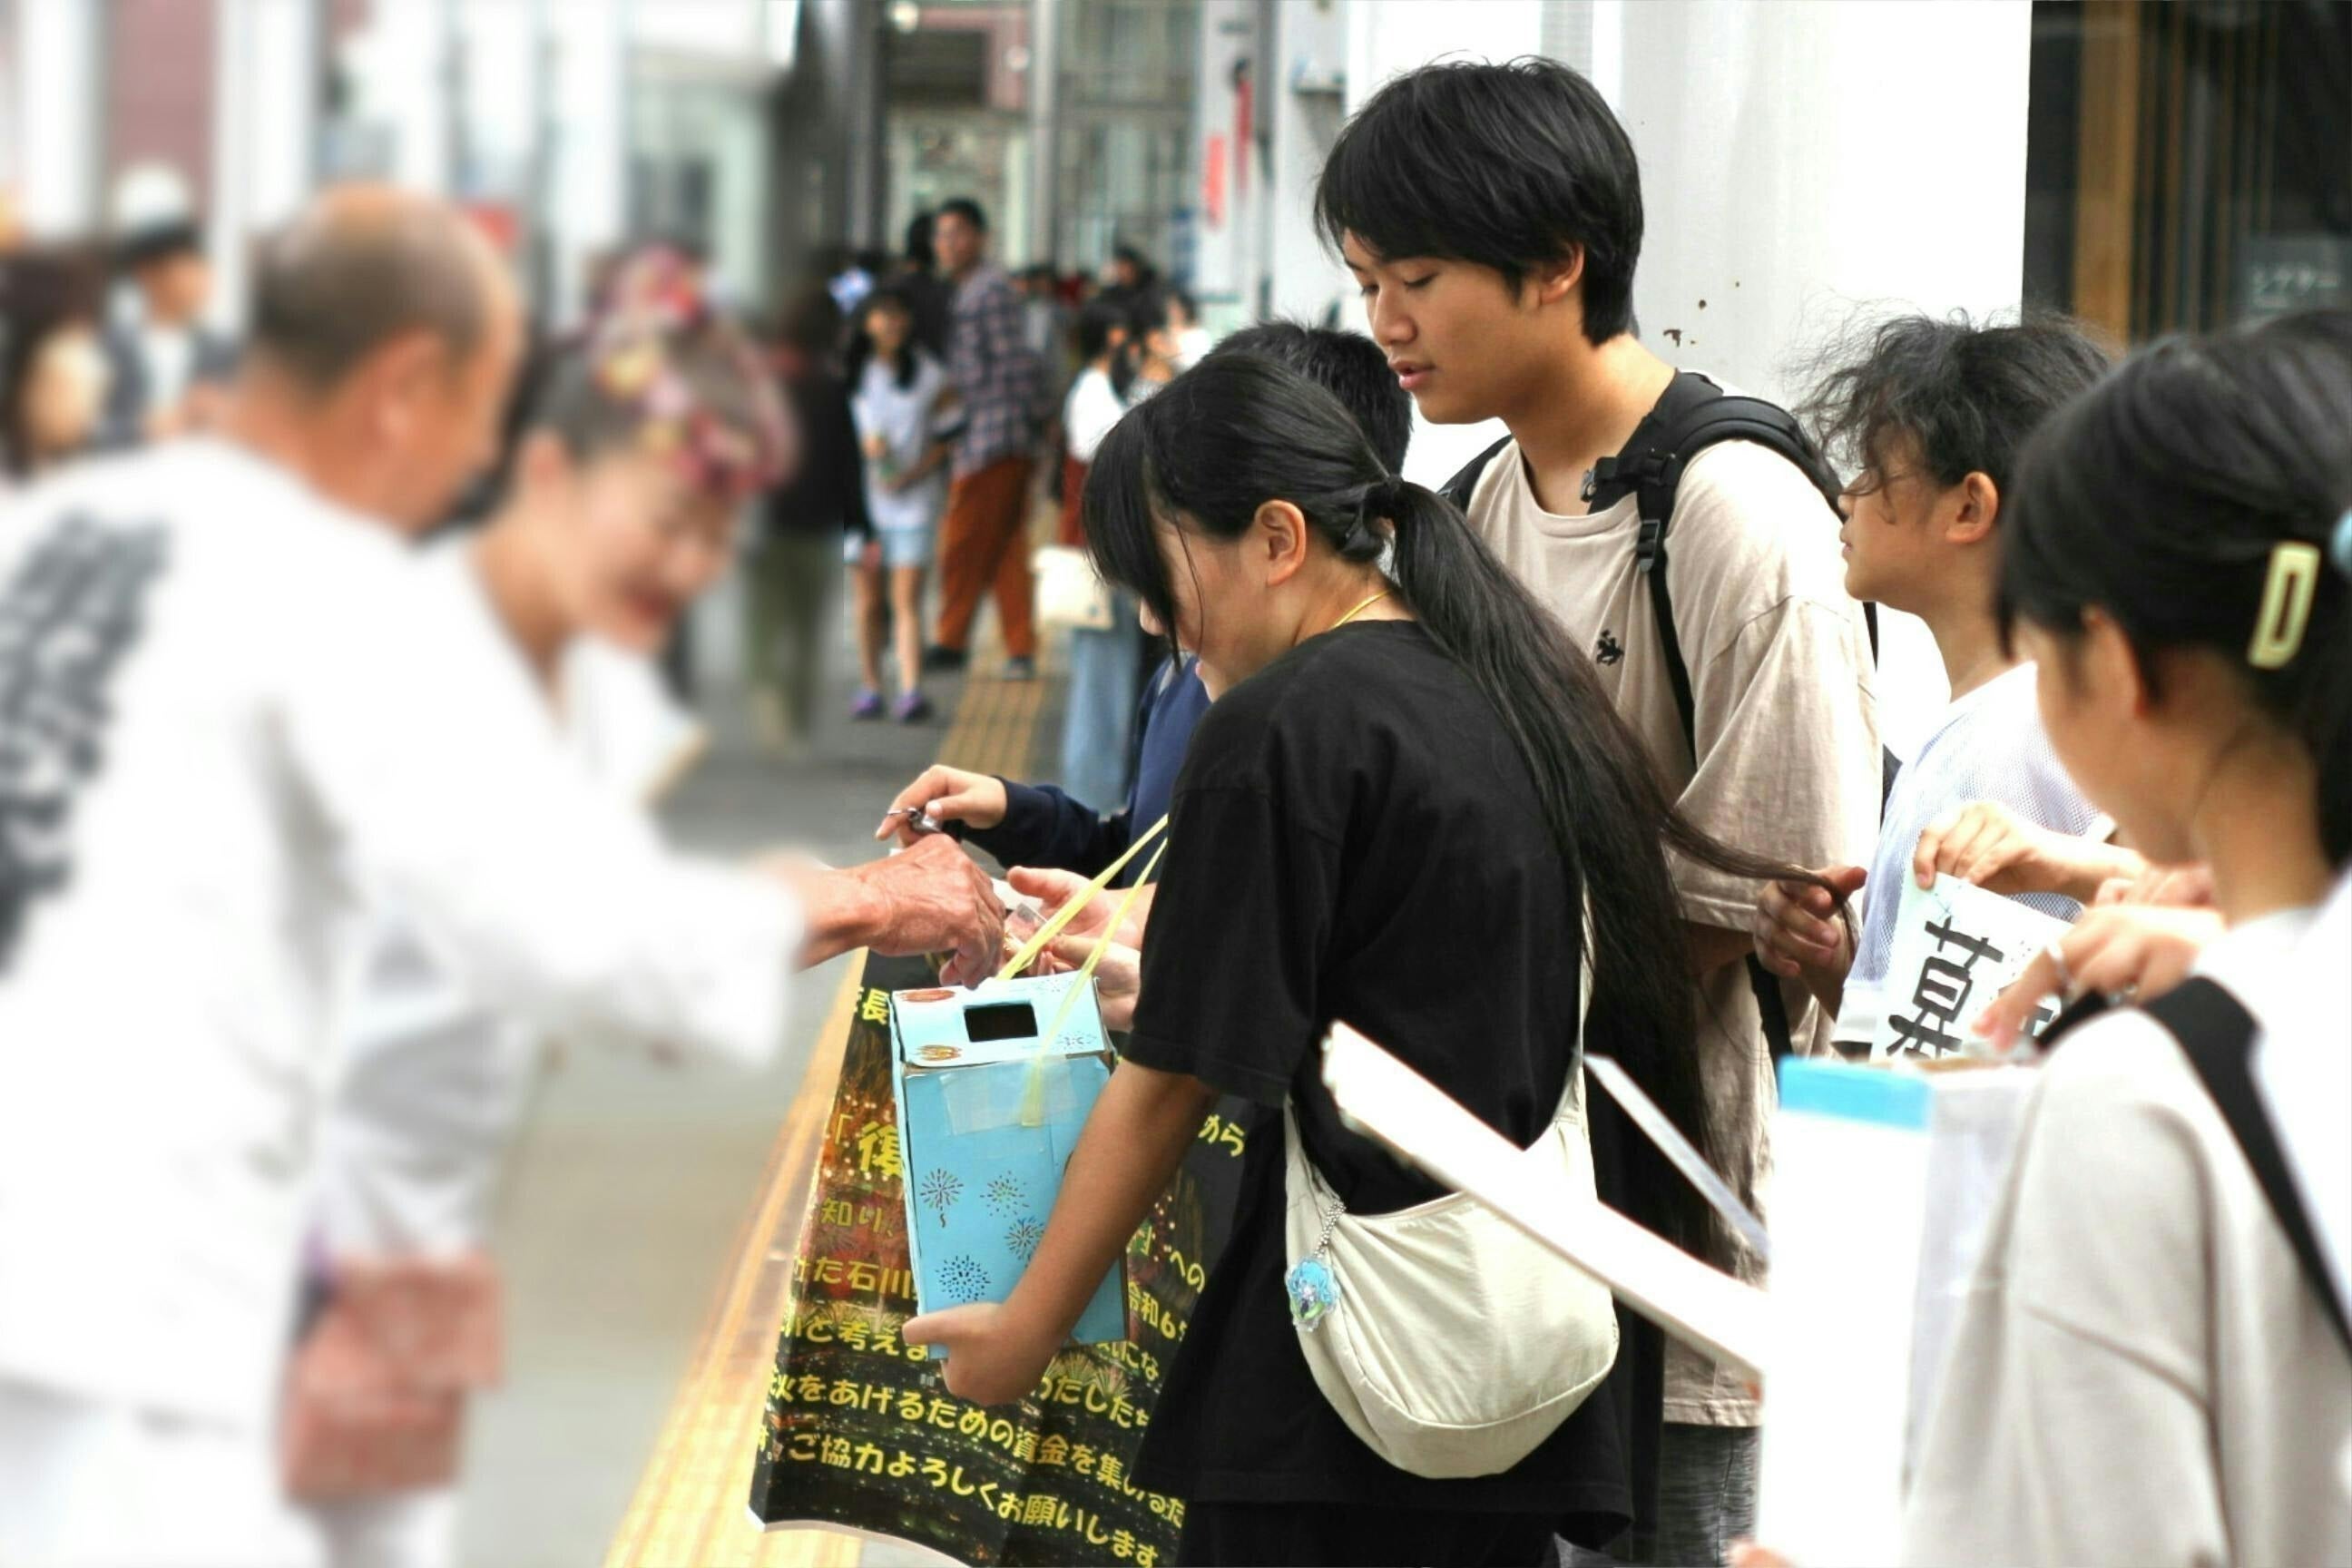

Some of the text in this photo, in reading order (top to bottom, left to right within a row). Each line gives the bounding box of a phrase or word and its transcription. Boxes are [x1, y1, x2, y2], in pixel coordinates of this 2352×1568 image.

[854, 987, 890, 1025] 長
[821, 1196, 894, 1238] 知り、
[793, 1256, 916, 1301] けた石川
[780, 1315, 928, 1361] いと考える
[769, 1363, 1186, 1529] 火をあげるための資金を集るた
